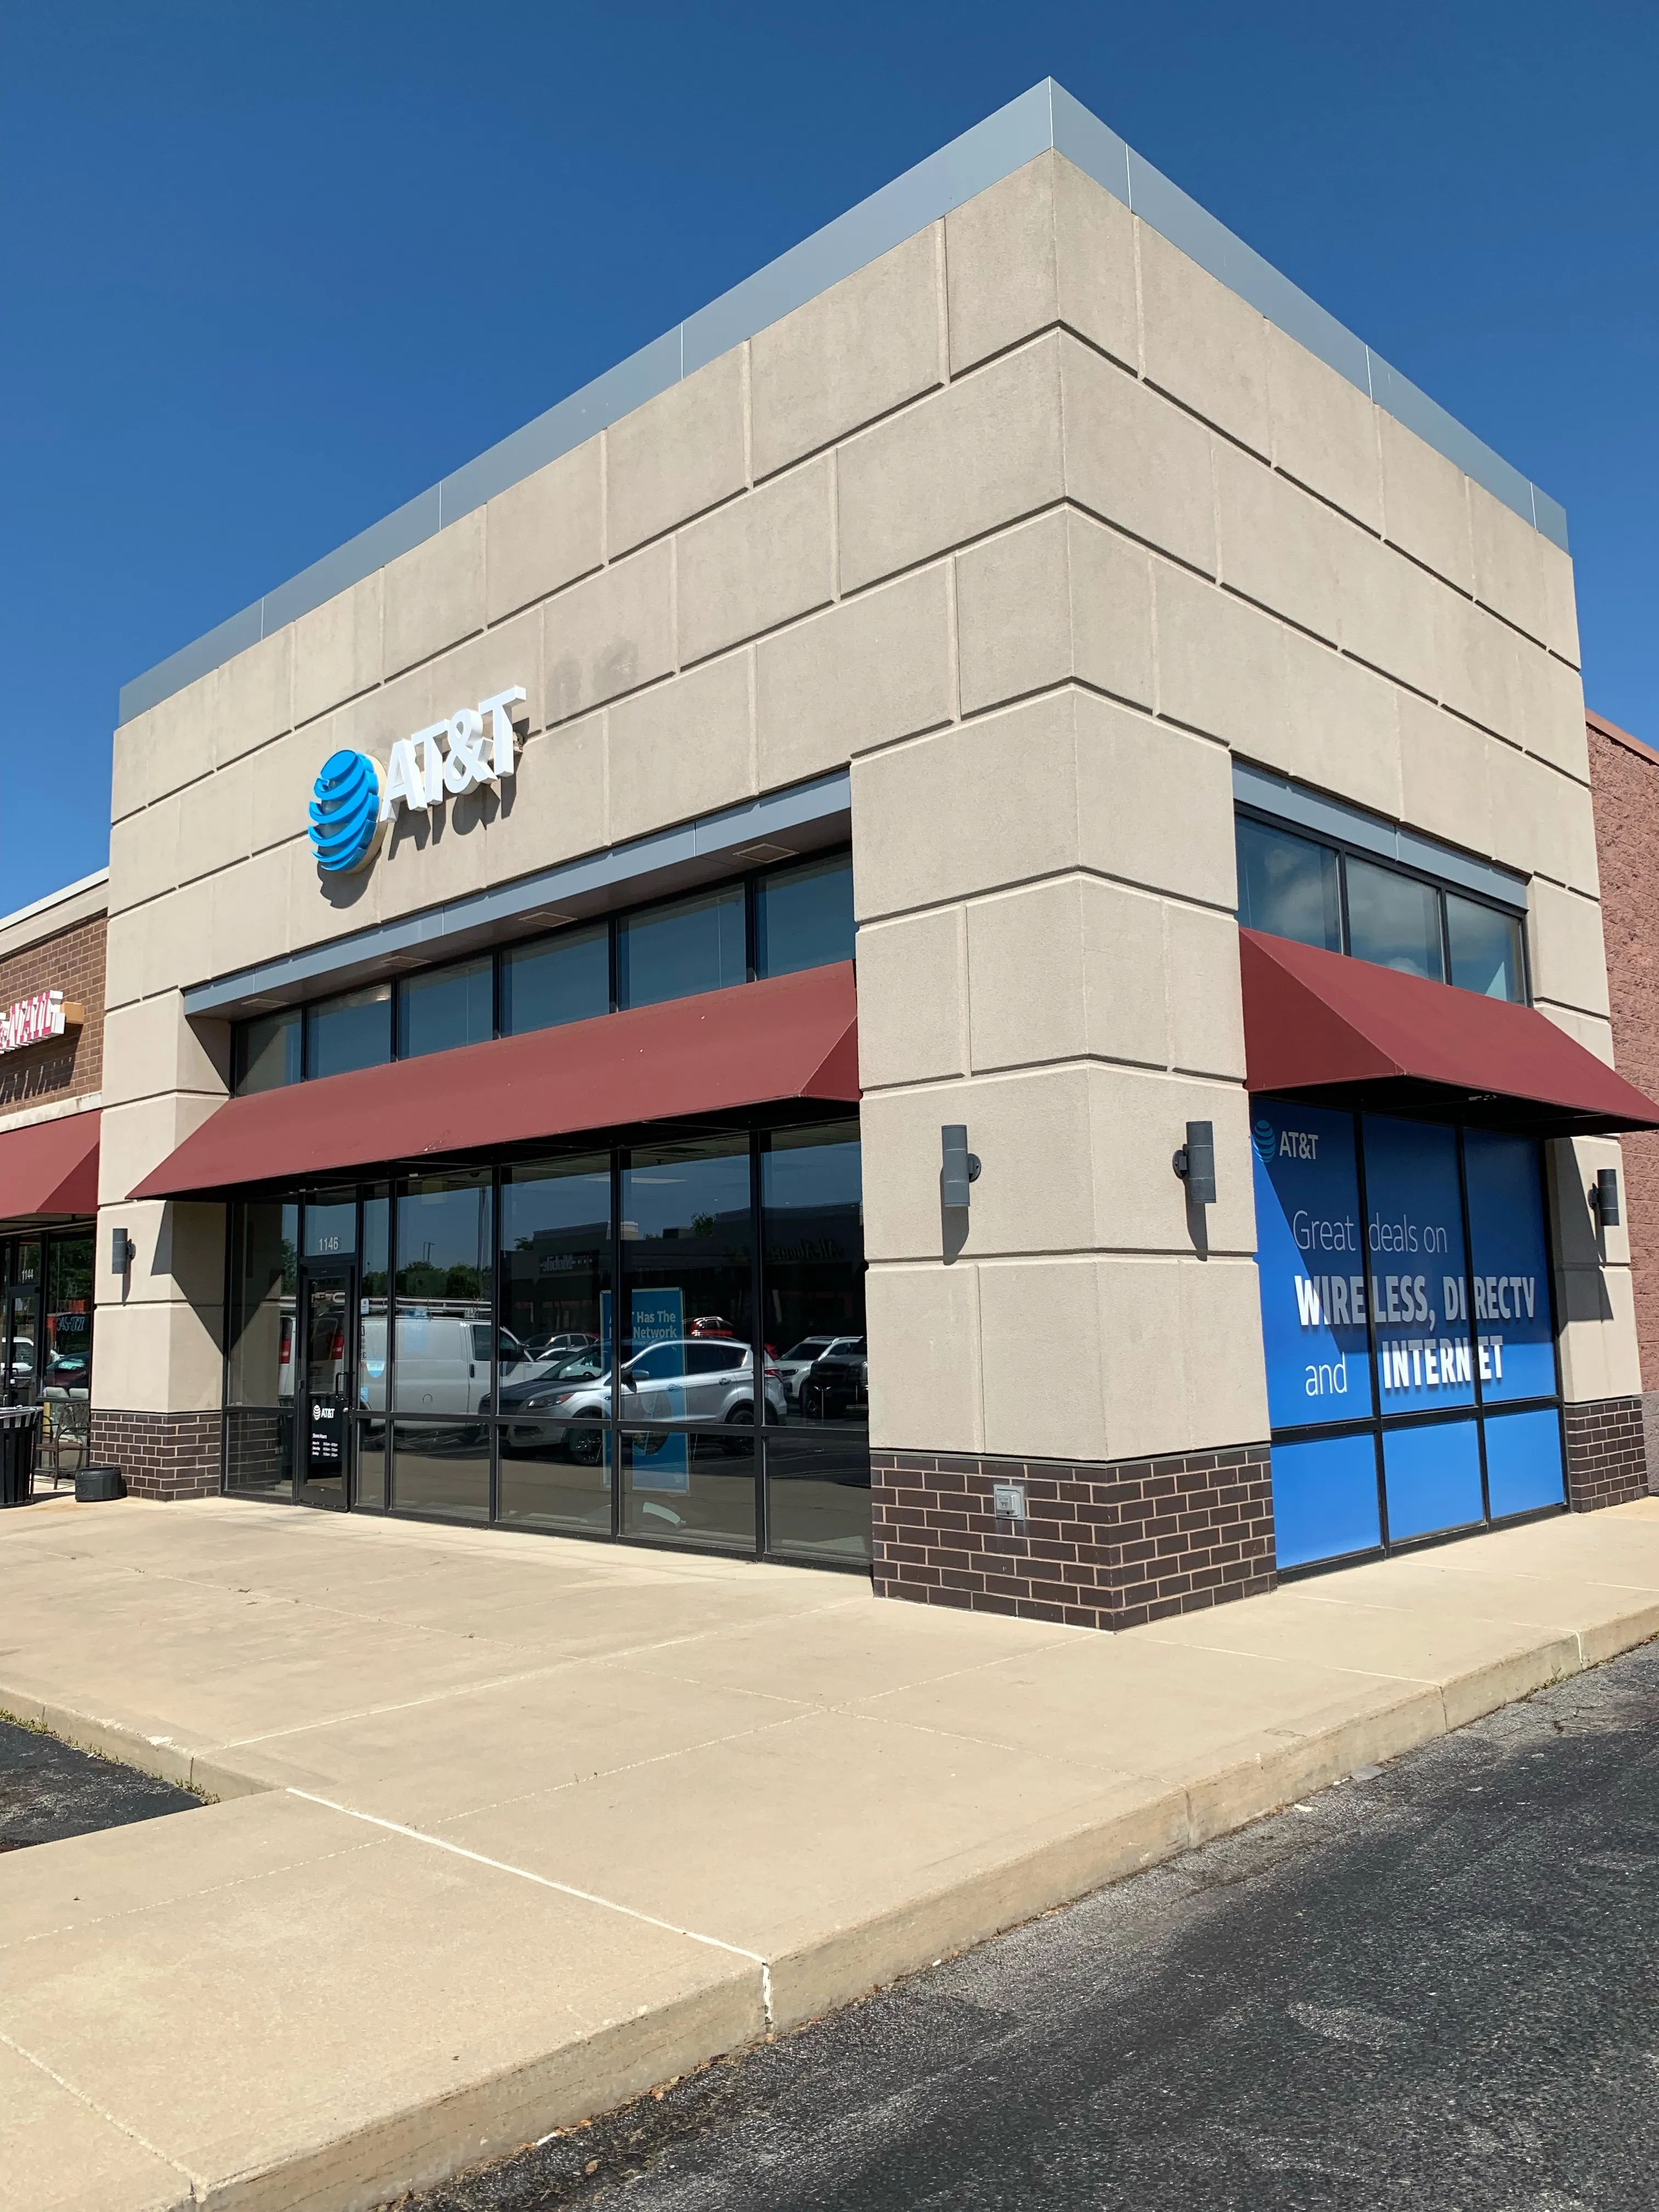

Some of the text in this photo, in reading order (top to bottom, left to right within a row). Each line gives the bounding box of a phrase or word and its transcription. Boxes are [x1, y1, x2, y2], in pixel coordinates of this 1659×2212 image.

[380, 685, 526, 822] AT&T
[1279, 1130, 1319, 1160] AT&T
[1293, 1210, 1448, 1254] Great deals on
[319, 1237, 338, 1251] 1146
[21, 1269, 33, 1282] 1144
[1294, 1275, 1535, 1331] WIRELESS, DIRECTV
[636, 1311, 655, 1323] Has
[657, 1310, 676, 1323] The
[633, 1325, 678, 1339] Network
[1305, 1335, 1504, 1396] and INTERNET
[321, 1408, 335, 1418] AT&T
